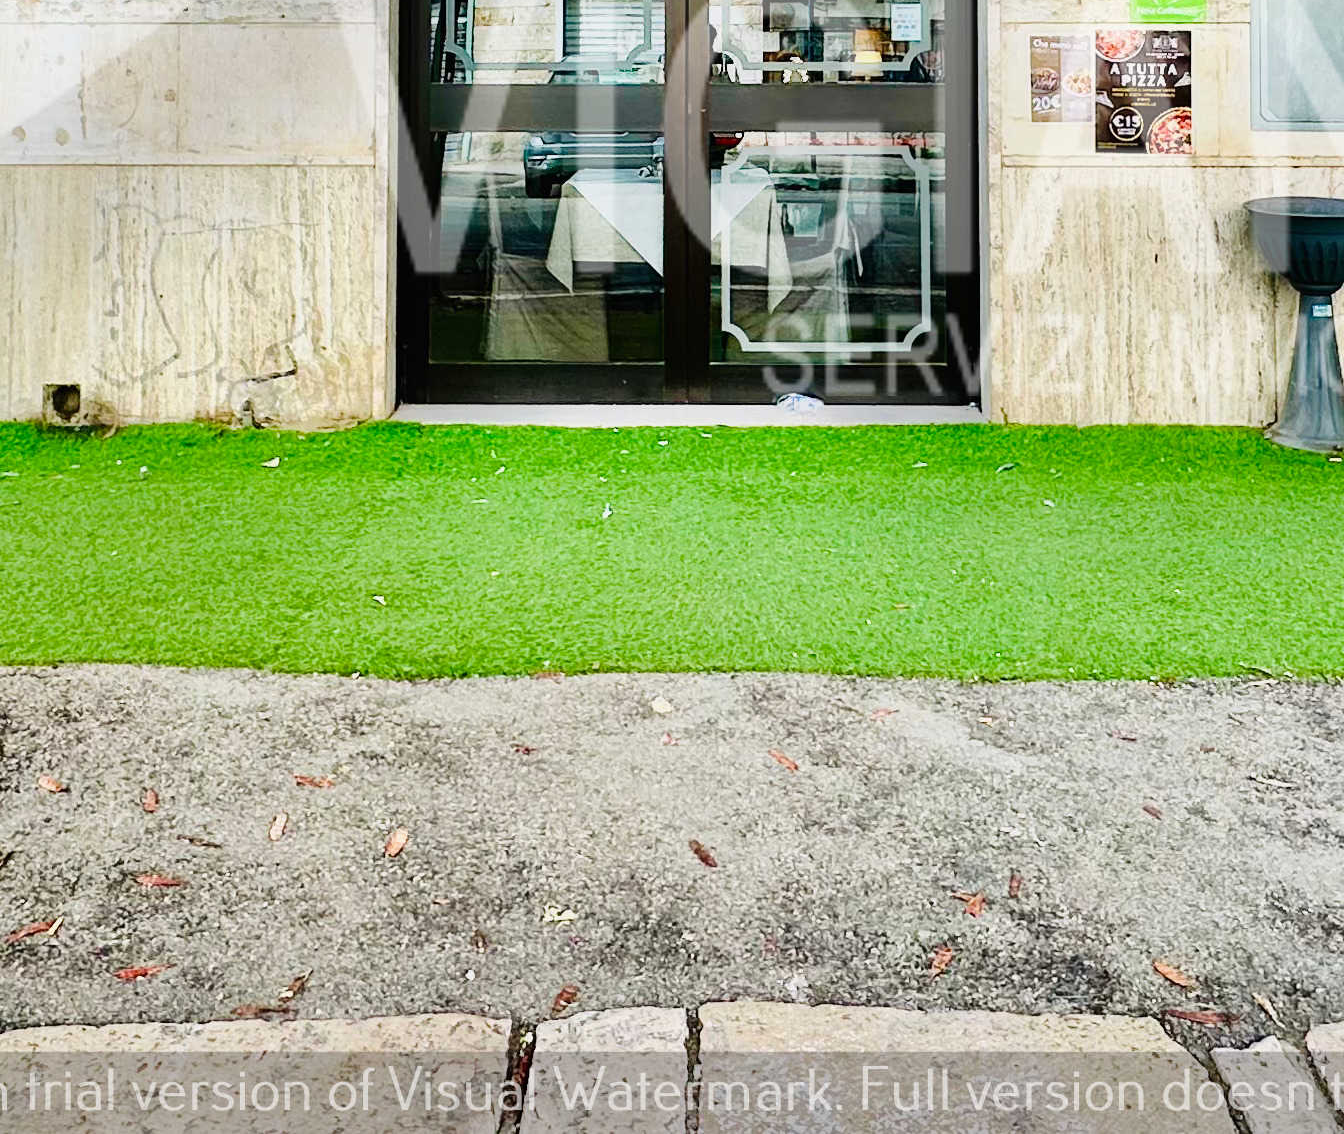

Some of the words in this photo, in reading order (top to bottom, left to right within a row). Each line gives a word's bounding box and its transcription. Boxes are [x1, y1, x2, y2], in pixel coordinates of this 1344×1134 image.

[1110, 63, 1121, 75] A
[1126, 63, 1178, 75] TUTTA
[1120, 75, 1167, 87] PIZZA
[1032, 95, 1062, 111] 20€
[1112, 115, 1141, 128] €15
